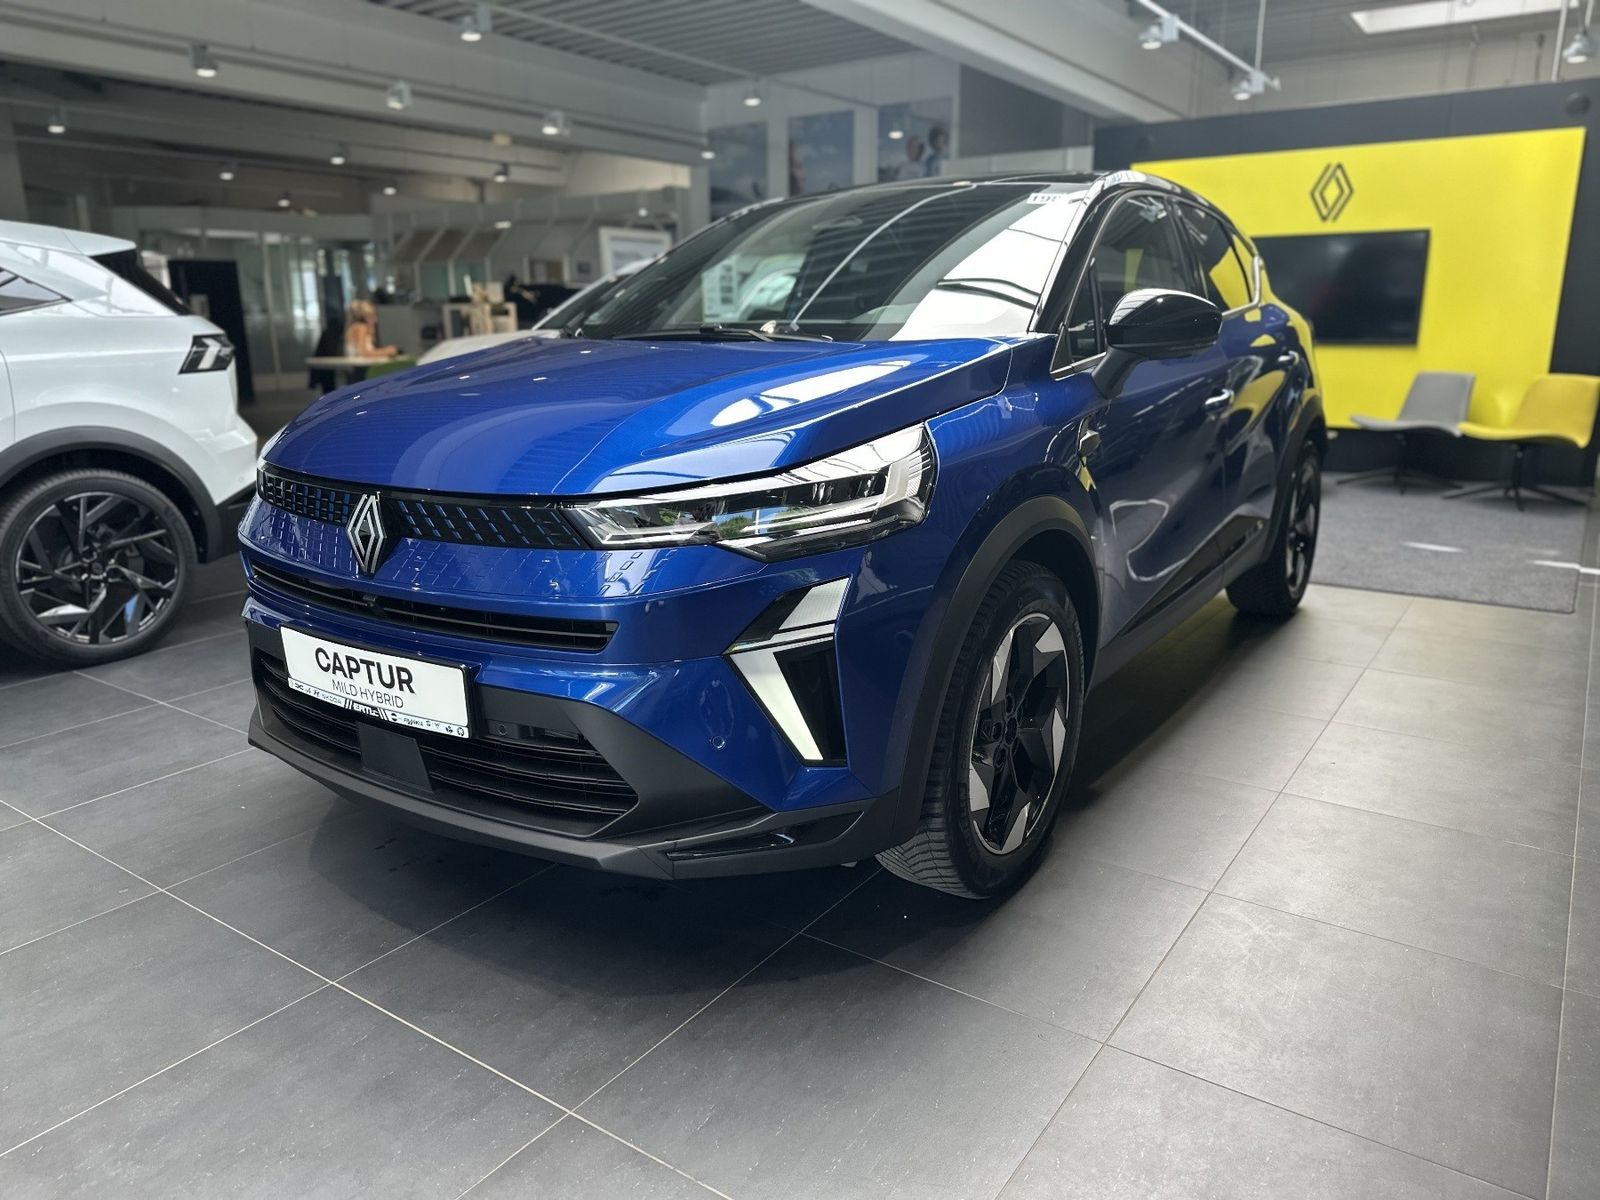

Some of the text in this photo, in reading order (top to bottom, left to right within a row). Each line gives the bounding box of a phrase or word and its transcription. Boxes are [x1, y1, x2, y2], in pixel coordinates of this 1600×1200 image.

[315, 647, 415, 693] CAPTUR
[332, 679, 404, 709] MILD HYBRID
